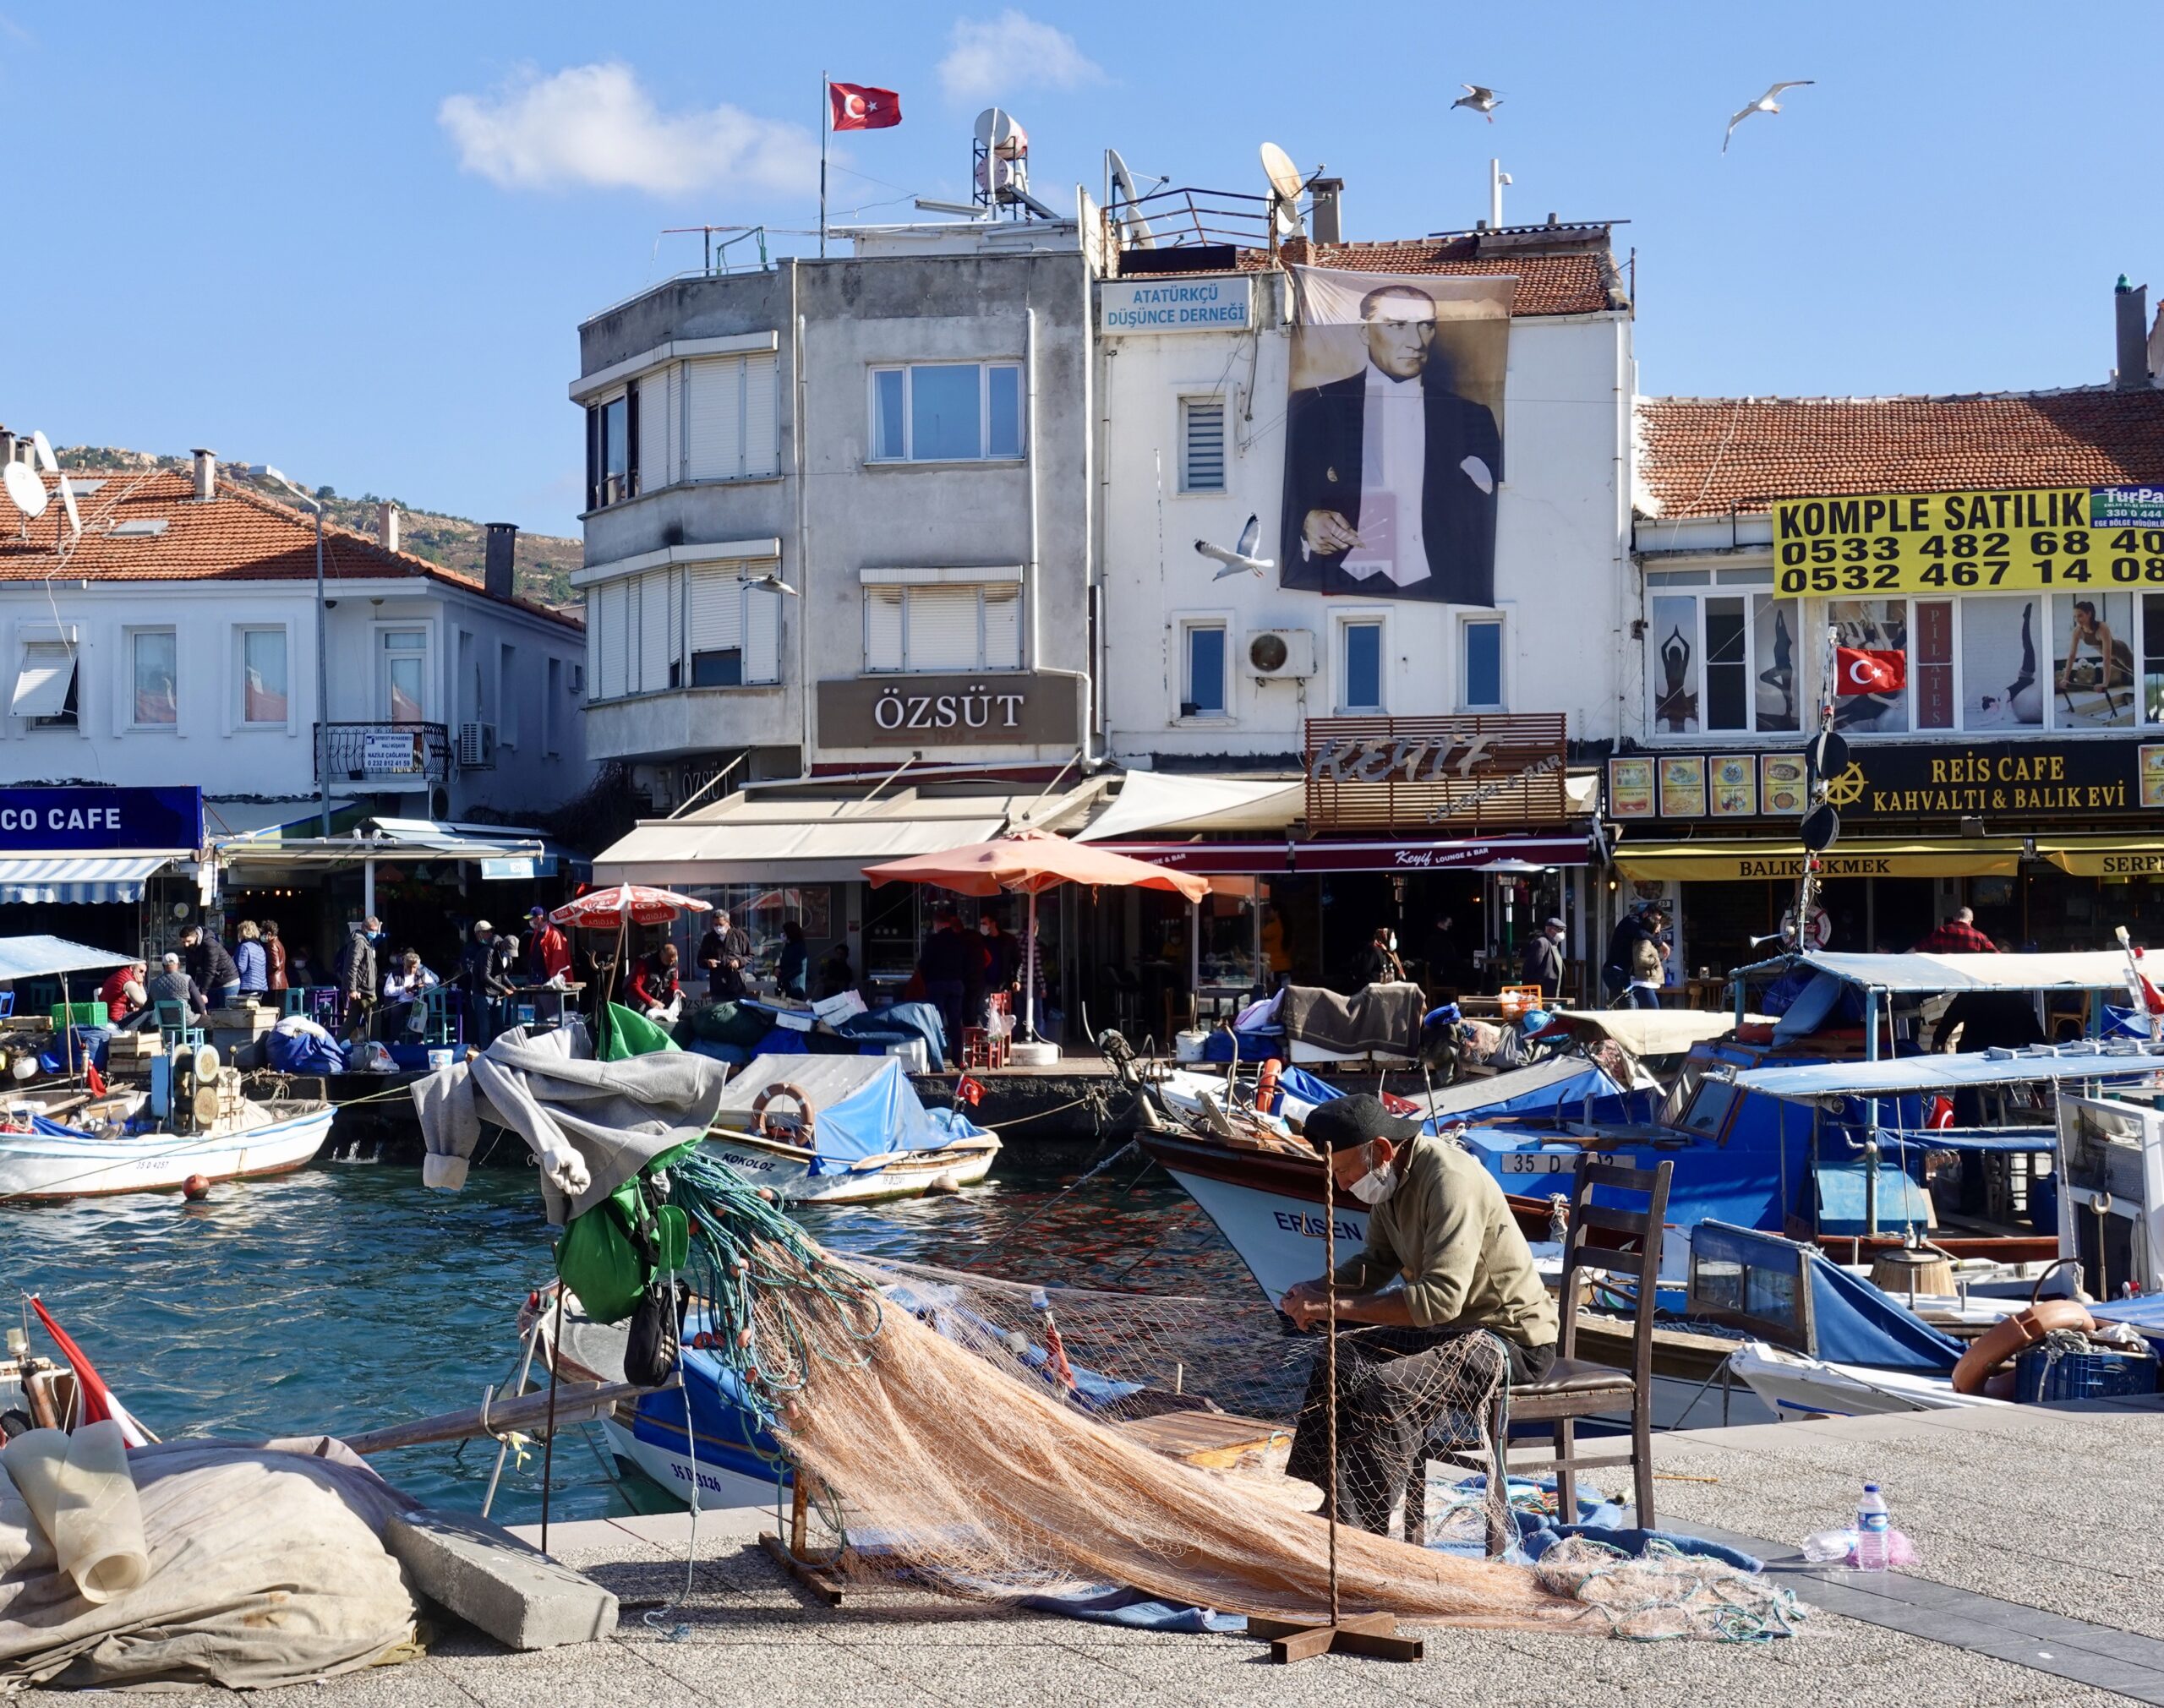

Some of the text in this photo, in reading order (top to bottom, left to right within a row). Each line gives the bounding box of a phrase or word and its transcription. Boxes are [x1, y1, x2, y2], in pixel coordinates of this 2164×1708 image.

[1134, 284, 1218, 304] ATATÜRKÇÜ
[1108, 303, 1244, 327] DÜŞÜNCE DERNEĞİ
[1779, 492, 2085, 538] KOMPLE SATILIK
[2107, 509, 2162, 518] 330 0 444
[2109, 518, 2131, 527] BÖLGE
[1782, 529, 2164, 566] 0533 482 68 40
[1780, 557, 2164, 593] 0532 467 14 08
[873, 684, 1025, 730] ÖZSÜT
[1932, 751, 2064, 783] REİS CAFE
[1426, 781, 1501, 825] LOUNGE
[1523, 754, 1564, 781] BAR
[1872, 779, 2126, 812] KAHVALTI & BALIK EVİ
[48, 808, 122, 831] CAFE
[1171, 853, 1187, 862] BAR
[1395, 850, 1433, 867] Keyif
[1435, 852, 1465, 864] LOUNGE
[1473, 848, 1489, 856] BAR
[1740, 859, 1803, 877] BALIK
[722, 1152, 776, 1172] KOKOLOZ
[1514, 1154, 1534, 1172] 35
[1549, 1155, 1560, 1173] D
[671, 1463, 685, 1481] 35
[695, 1473, 722, 1492] 3126
